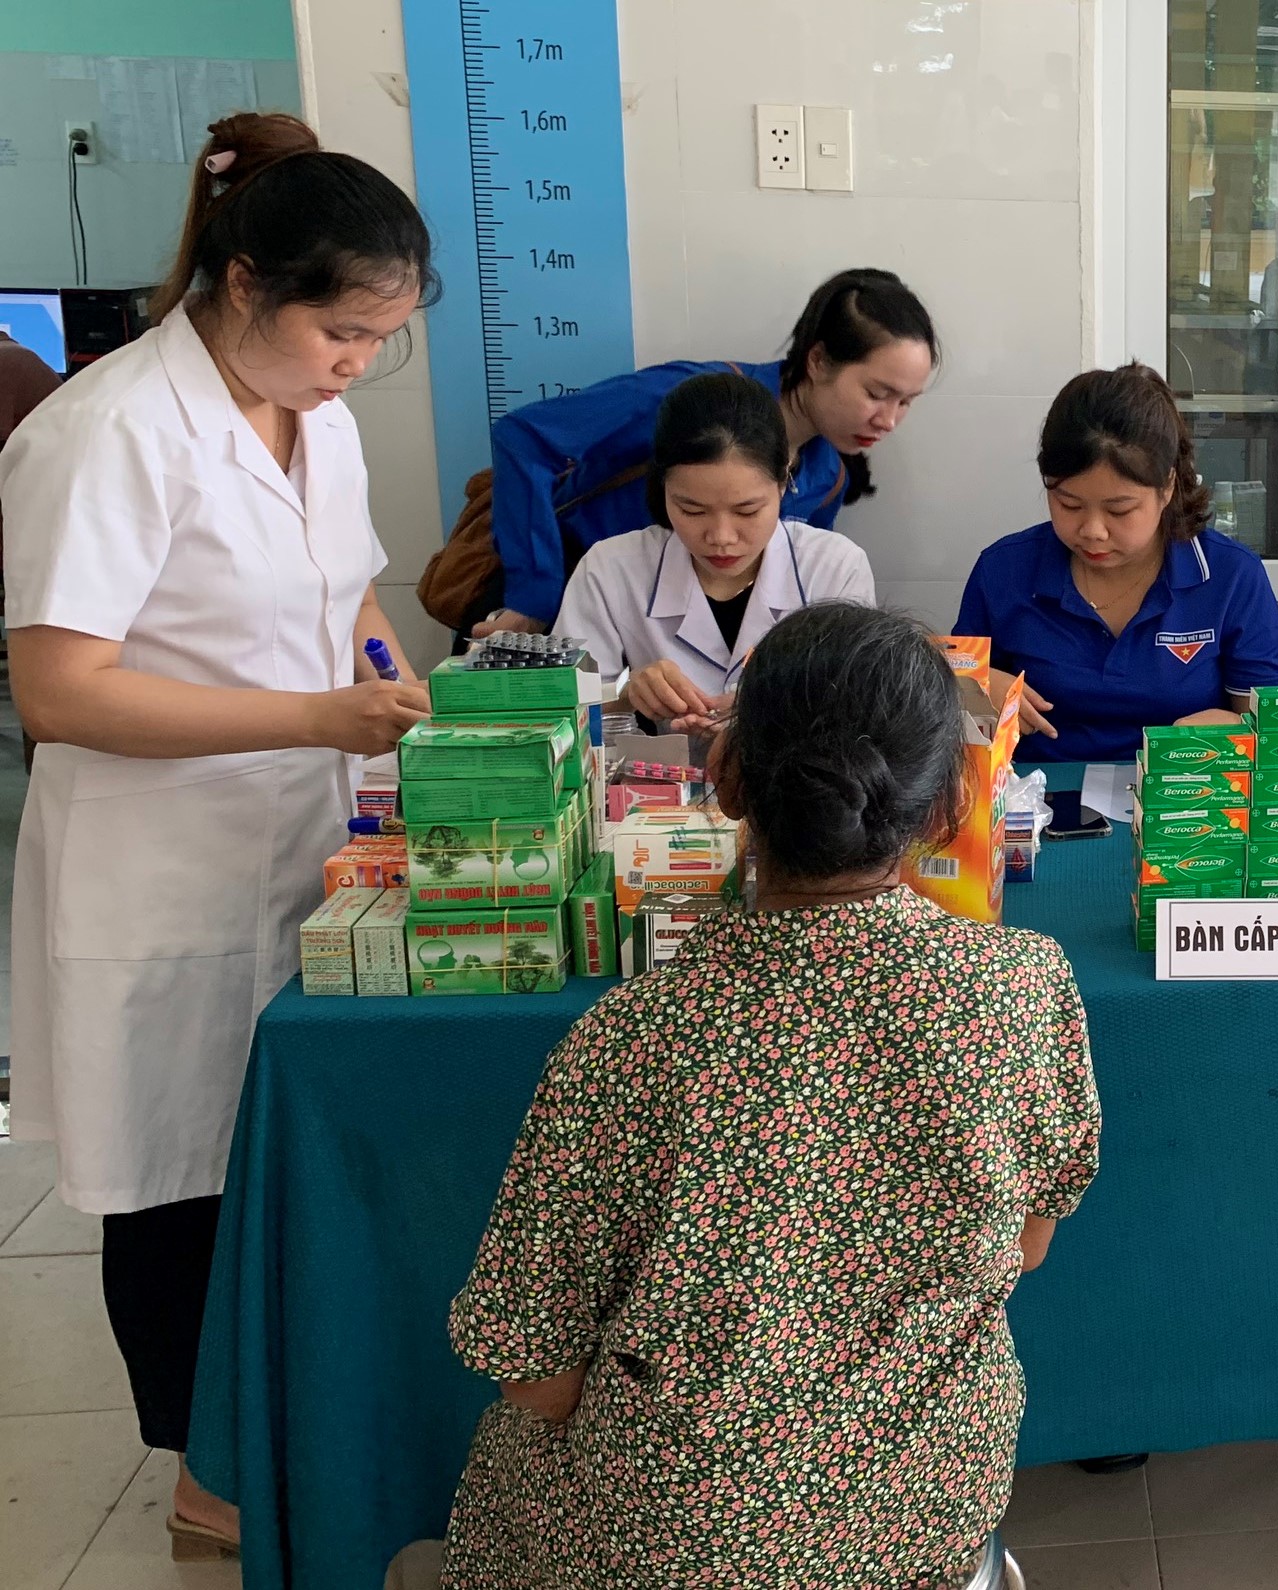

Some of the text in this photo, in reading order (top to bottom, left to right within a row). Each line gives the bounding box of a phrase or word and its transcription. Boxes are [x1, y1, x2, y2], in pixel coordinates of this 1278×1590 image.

[516, 38, 563, 63] 1,7m
[521, 109, 567, 134] 1,6m
[525, 179, 571, 203] 1,5m
[529, 248, 575, 272] 1,4m
[533, 316, 579, 339] 1,3m
[1168, 751, 1207, 759] Berocca
[1164, 788, 1203, 796] Berocca
[1164, 826, 1202, 834] Berocca
[1188, 858, 1226, 867] Berocca
[631, 879, 709, 892] Lactobacill
[655, 928, 689, 939] GLUCO
[1175, 920, 1224, 951] BÀN
